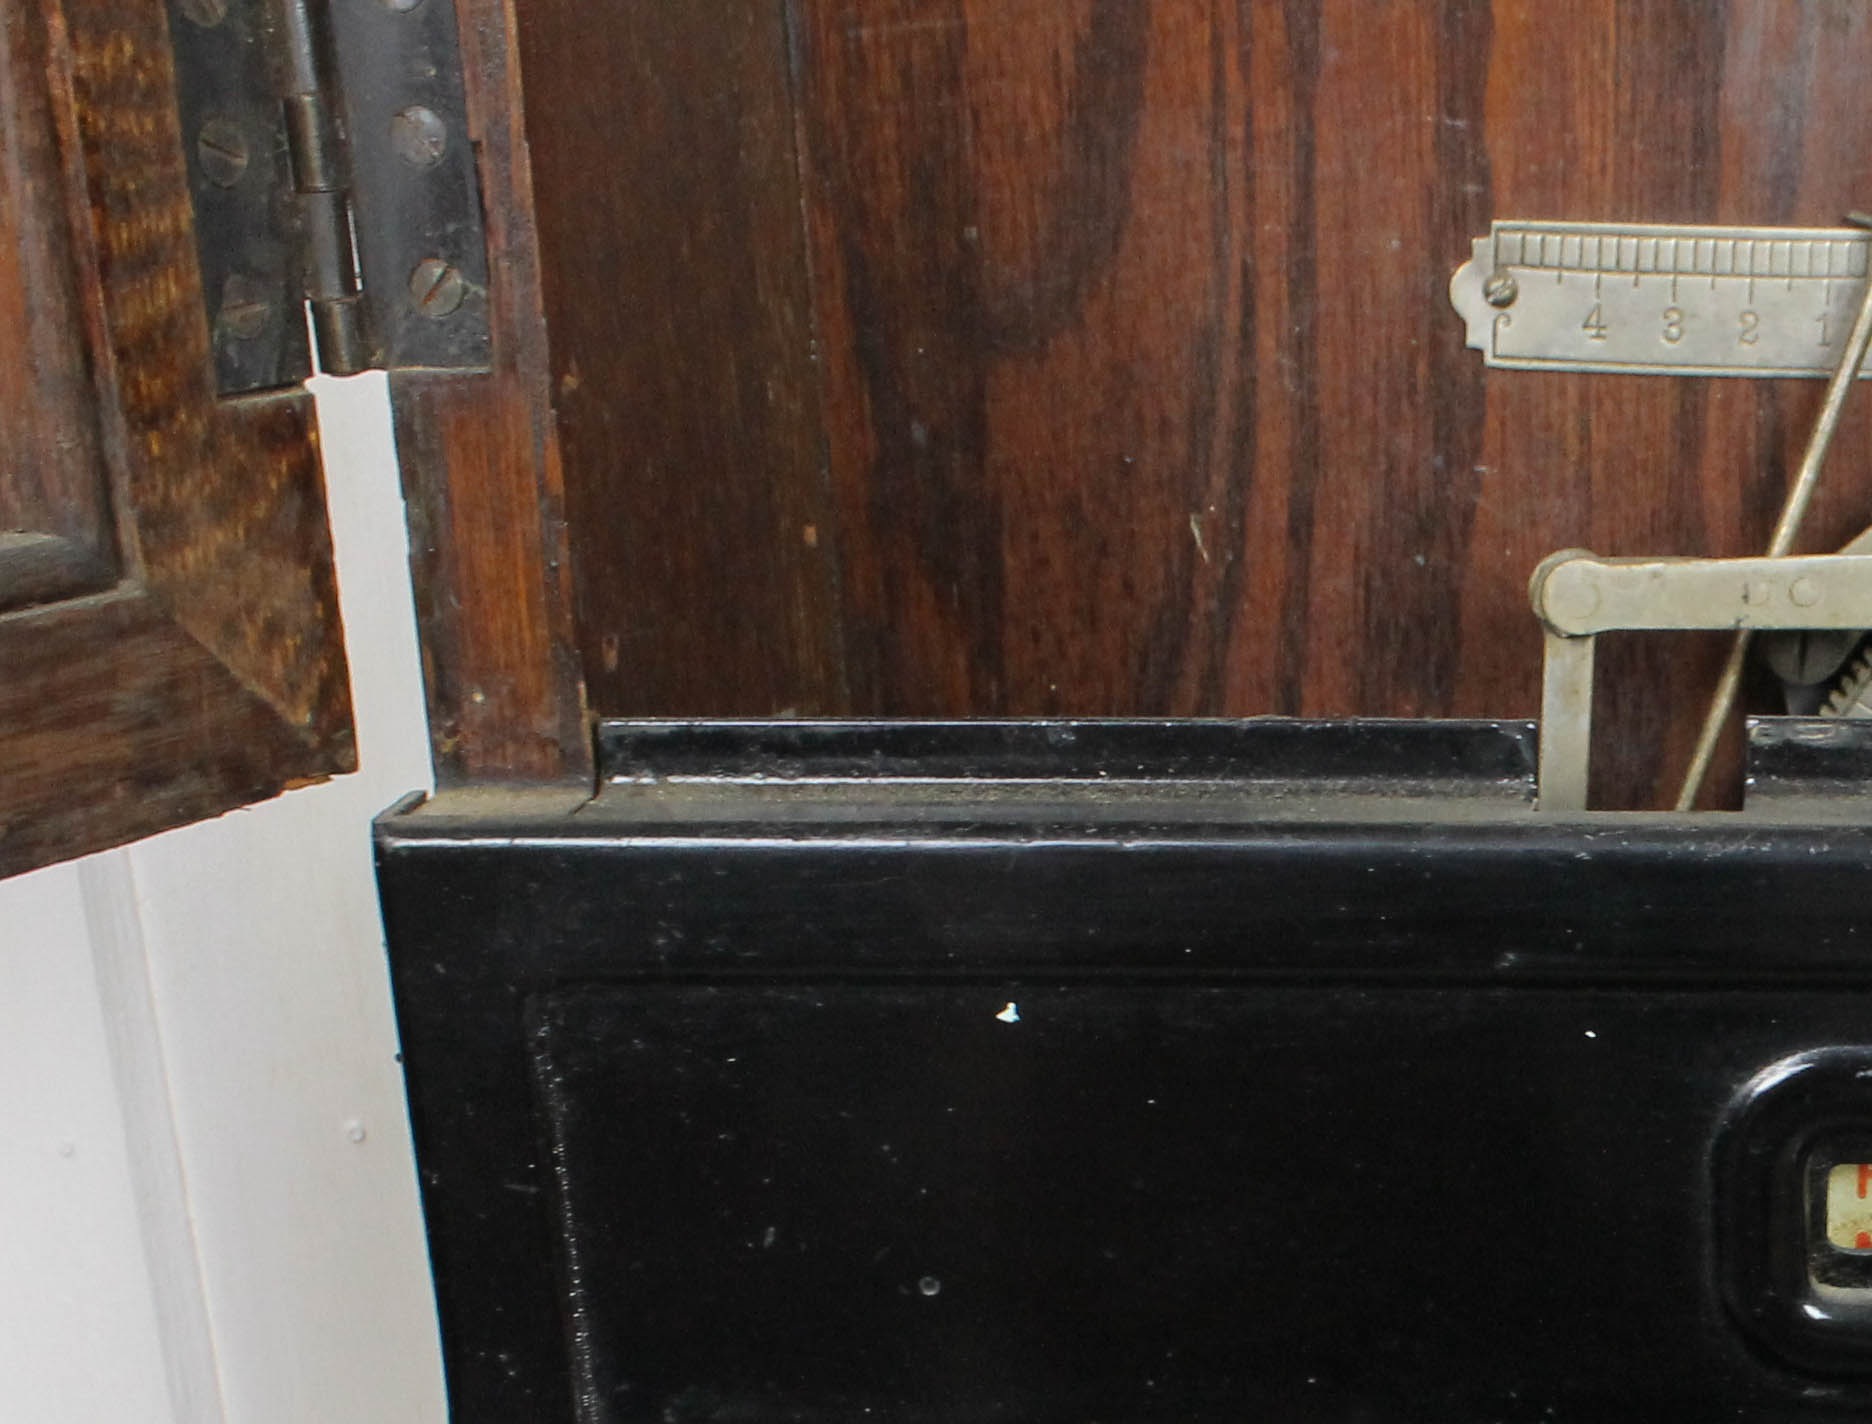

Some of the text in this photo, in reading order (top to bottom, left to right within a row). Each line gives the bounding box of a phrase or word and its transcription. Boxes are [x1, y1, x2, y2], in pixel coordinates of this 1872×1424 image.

[1580, 304, 1608, 341] 4
[1661, 306, 1686, 345] 3
[1738, 310, 1761, 347] 2
[1814, 313, 1834, 348] 1
